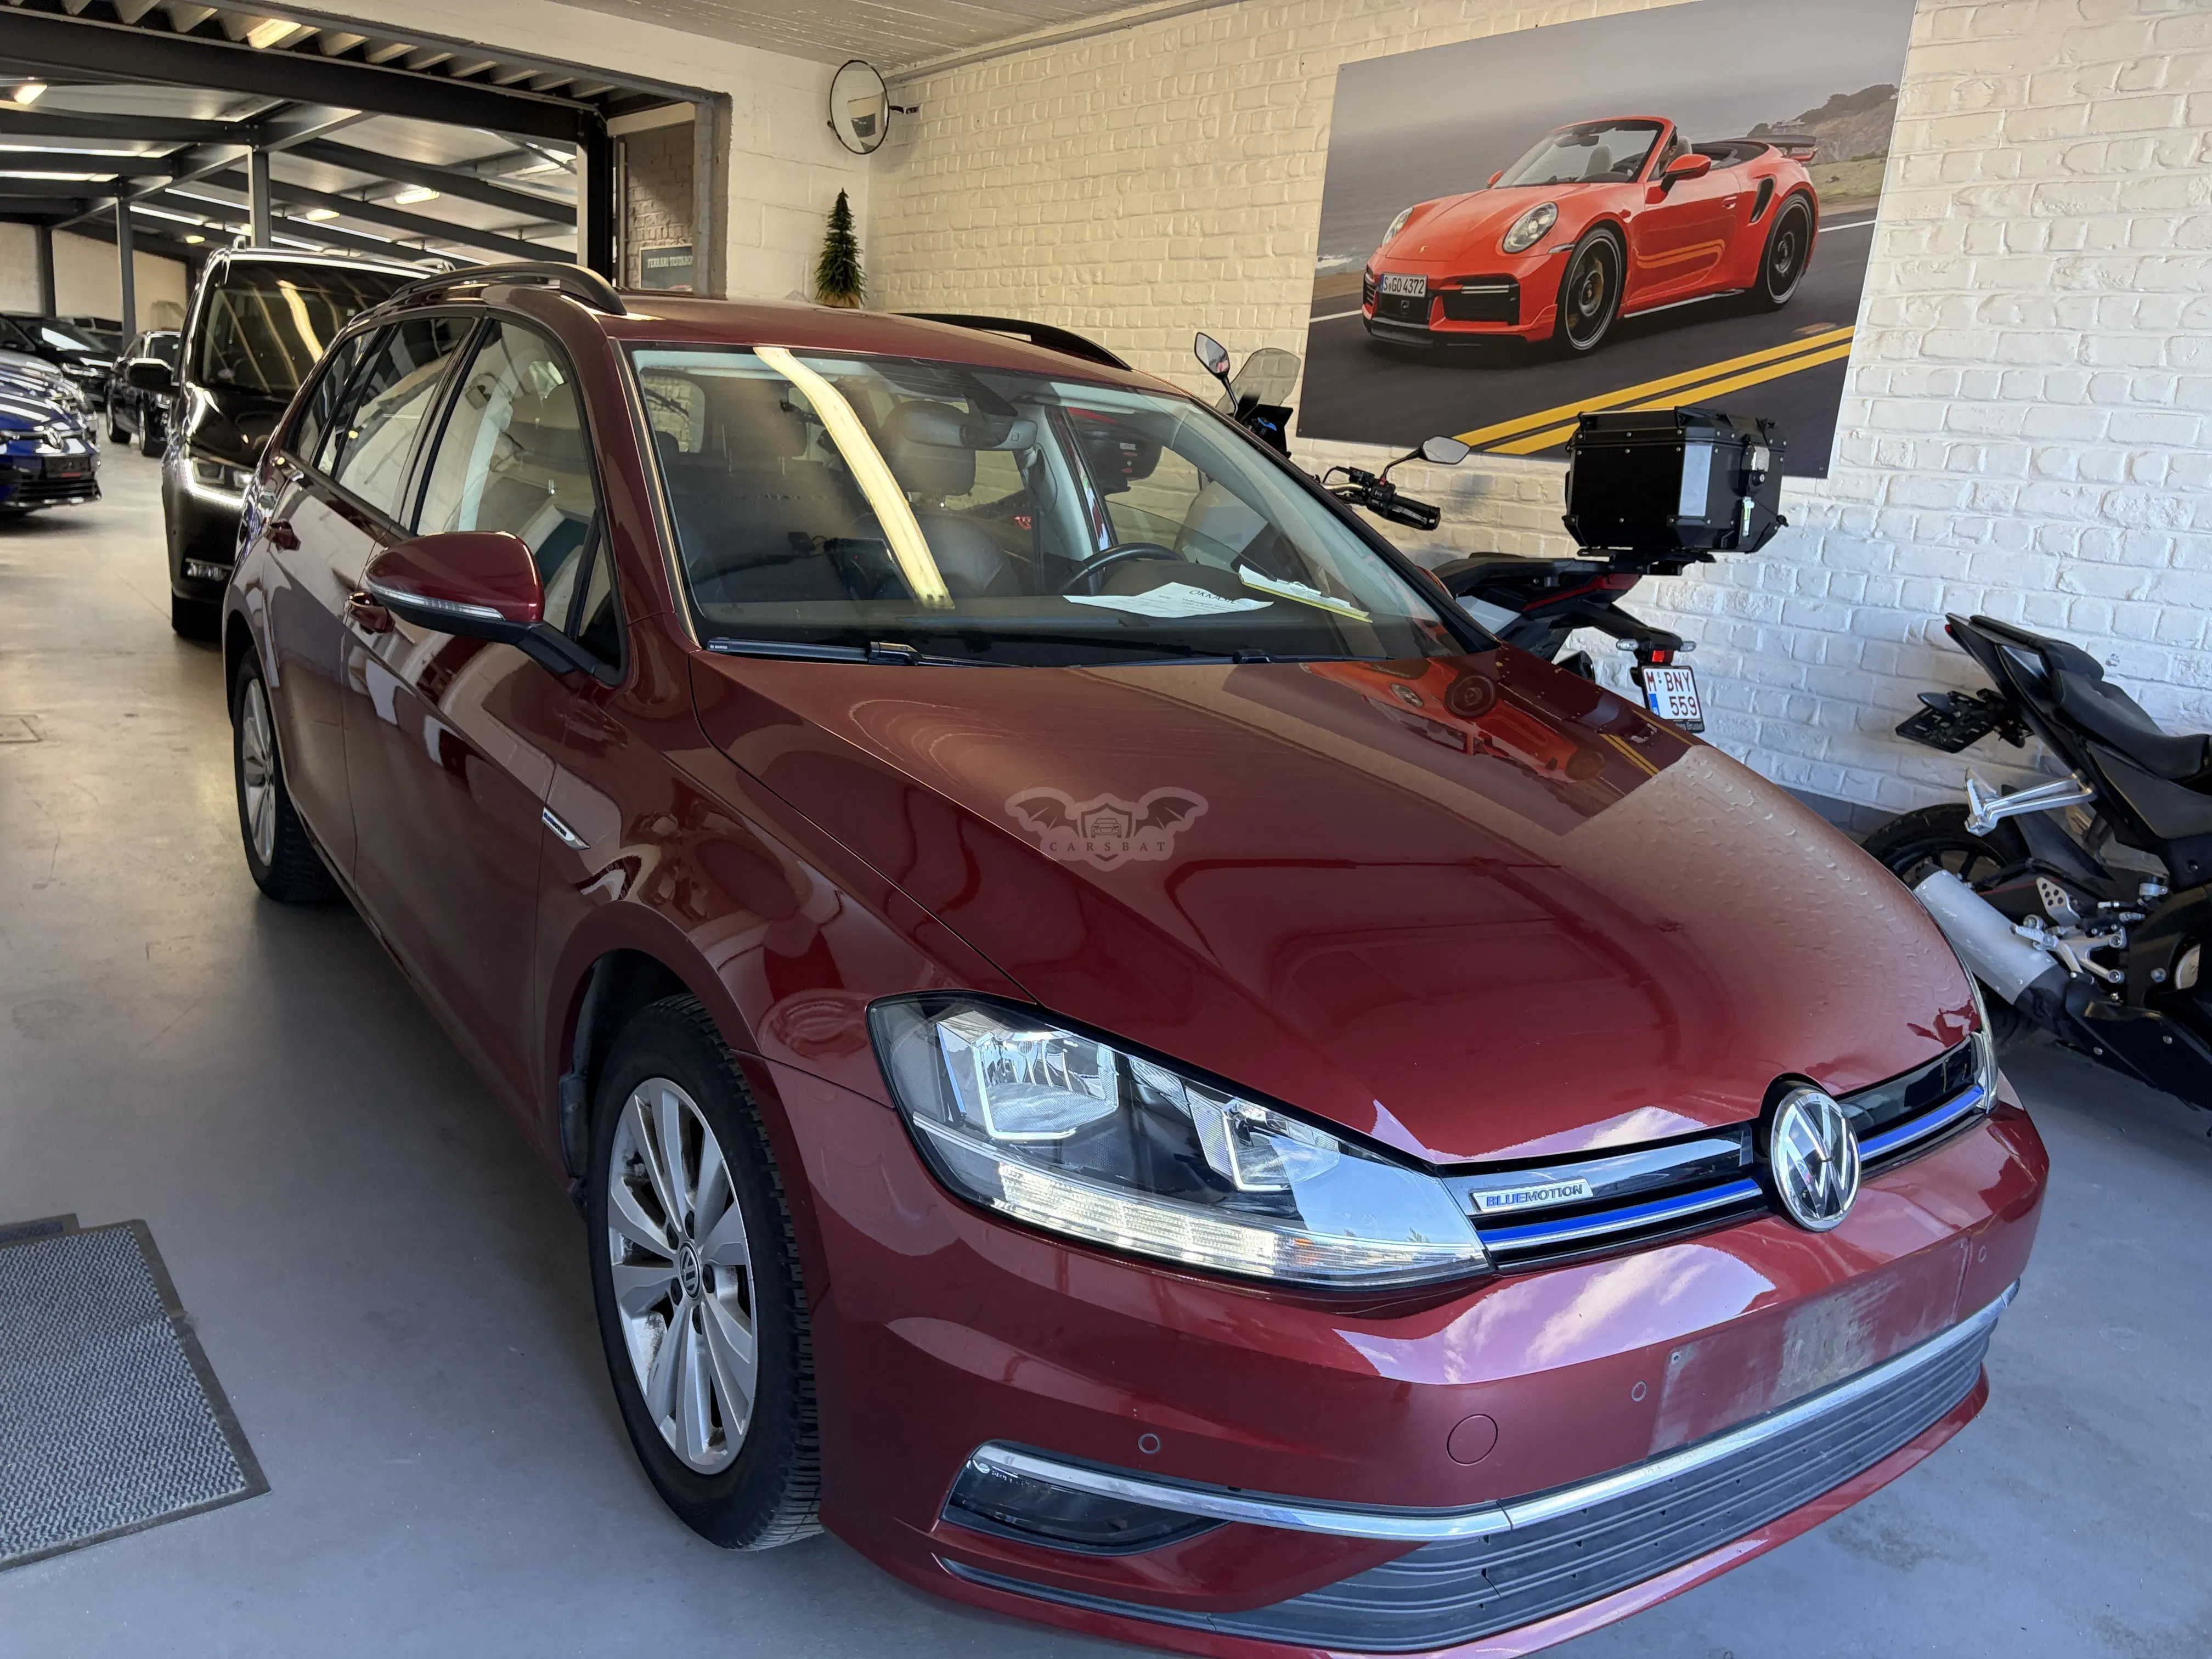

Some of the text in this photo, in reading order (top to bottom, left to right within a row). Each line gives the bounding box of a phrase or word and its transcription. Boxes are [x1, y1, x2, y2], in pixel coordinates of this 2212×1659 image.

[1384, 276, 1389, 291] S
[1403, 278, 1425, 295] 4372
[1668, 696, 1697, 716] 559
[1486, 1184, 1583, 1207] BLUEMOTION
